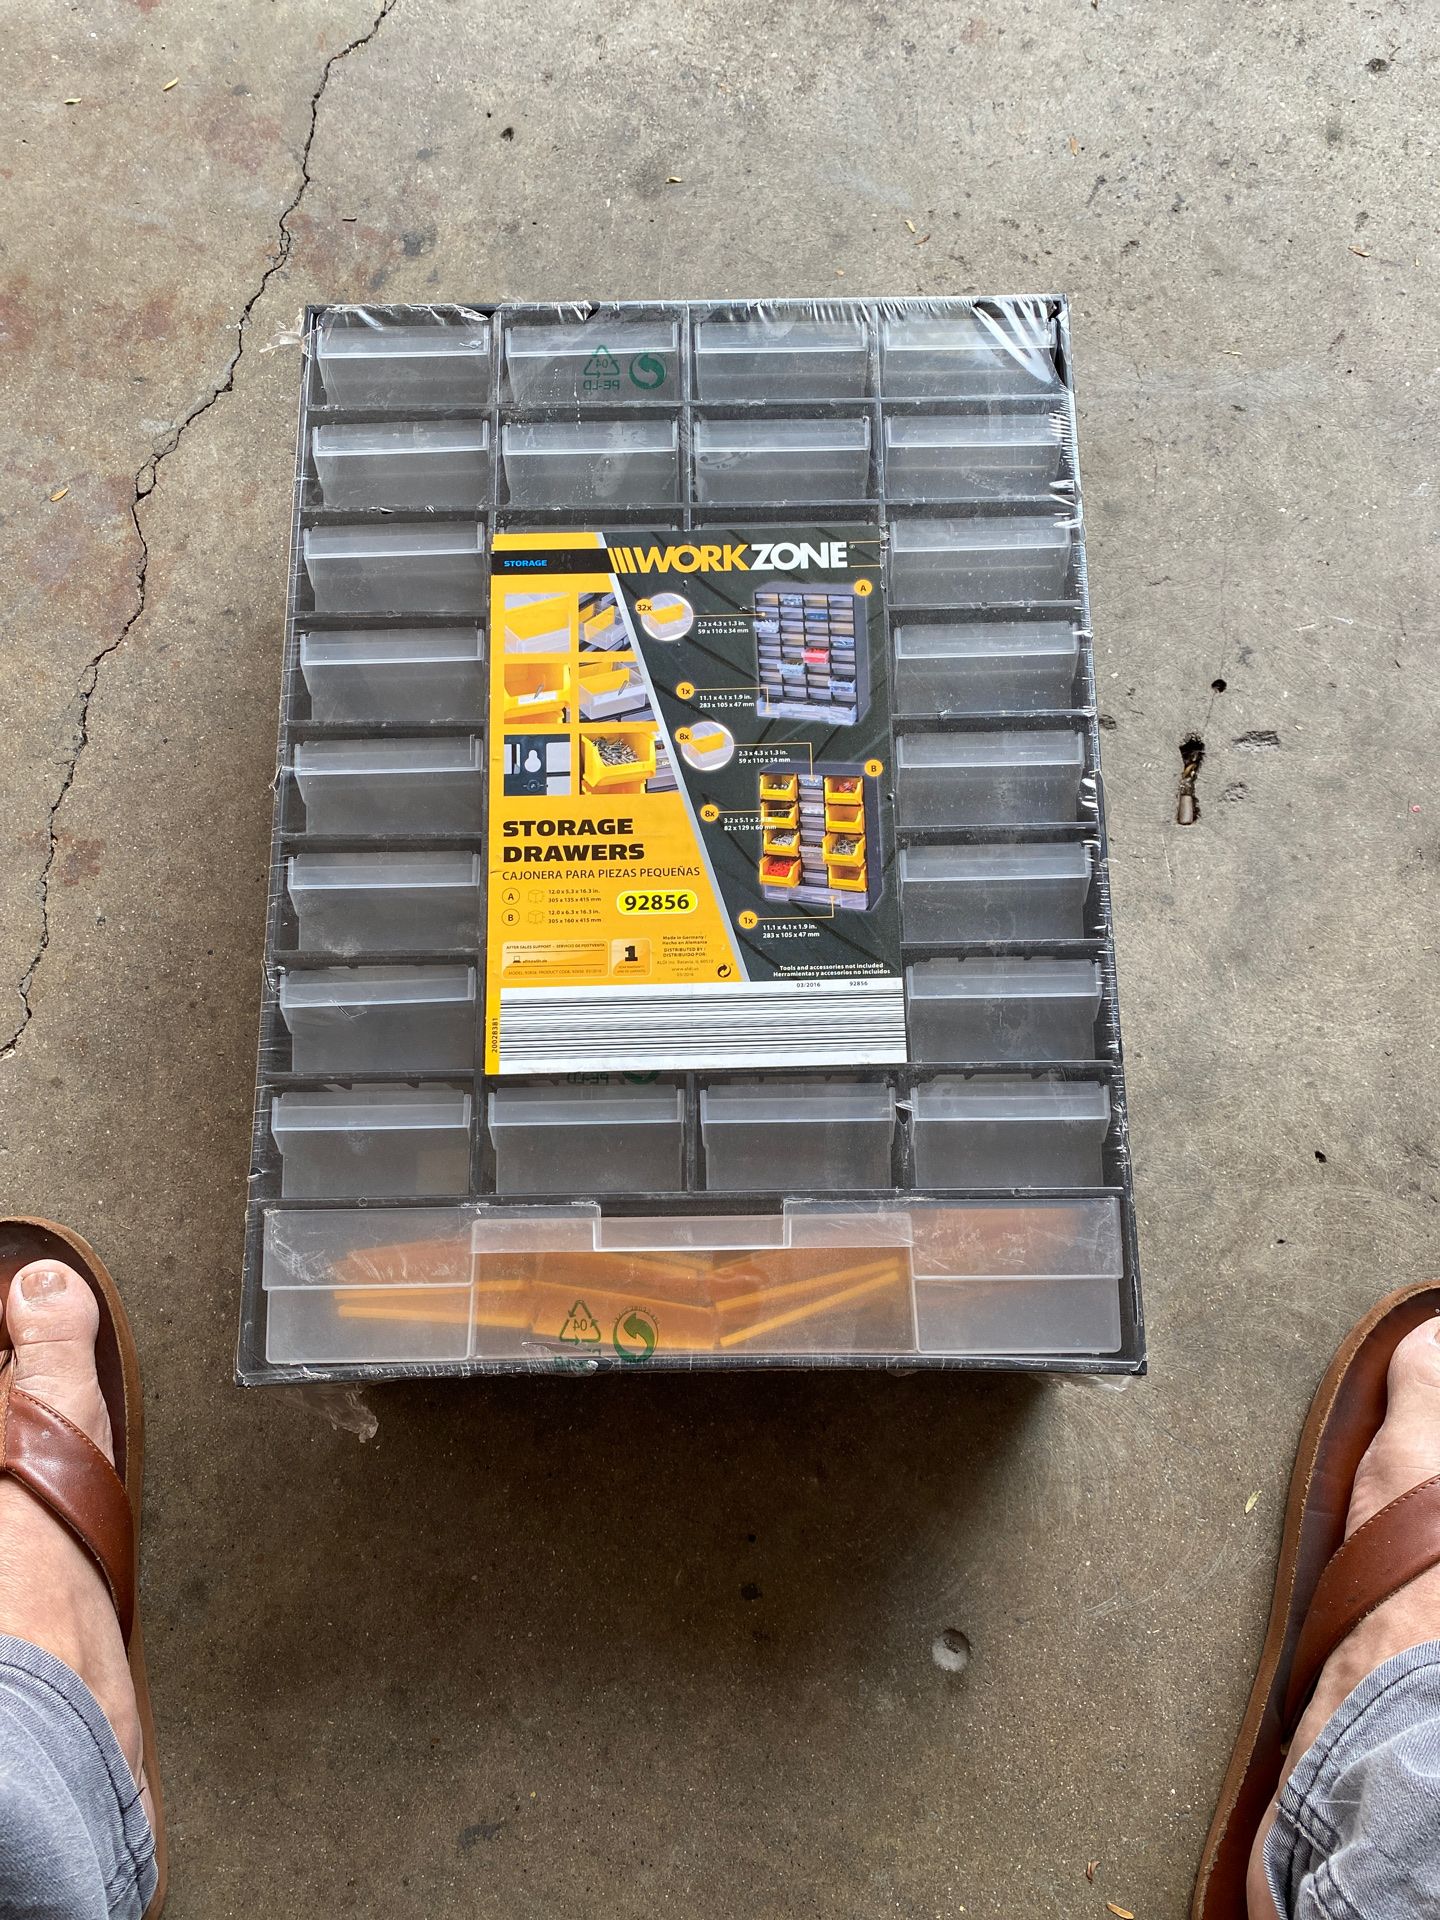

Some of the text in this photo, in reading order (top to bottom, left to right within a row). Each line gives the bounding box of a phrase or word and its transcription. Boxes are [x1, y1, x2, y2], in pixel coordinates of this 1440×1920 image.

[637, 604, 652, 612] 32x
[502, 818, 634, 837] STORAGE
[503, 844, 645, 862] DRAWERS
[502, 865, 700, 880] CAJONERA PARA PIEZAS PEQUEÑAS
[625, 895, 689, 910] 92856
[625, 946, 638, 961] 1
